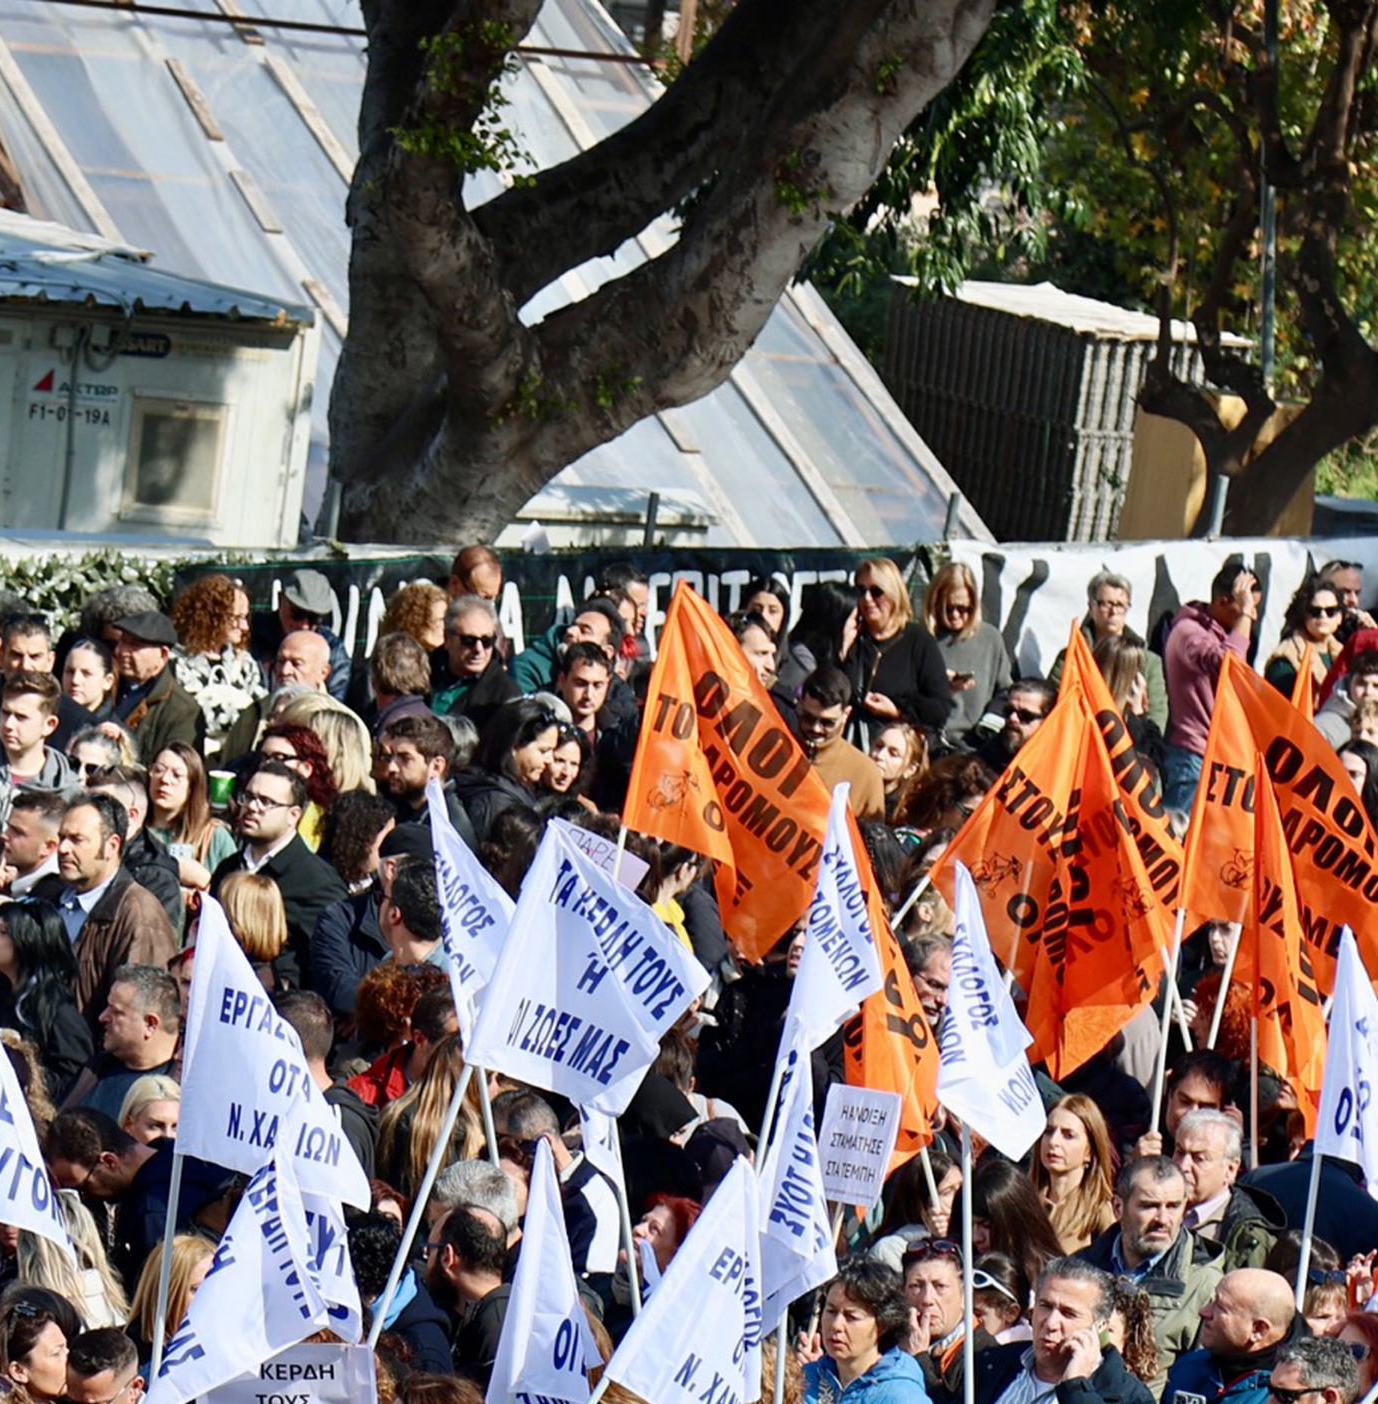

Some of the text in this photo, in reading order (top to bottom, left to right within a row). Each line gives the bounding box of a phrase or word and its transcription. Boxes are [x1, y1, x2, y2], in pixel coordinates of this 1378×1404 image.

[623, 948, 686, 1022] ΤΟΥΣ
[521, 1003, 583, 1063] ΖΩΕΣ
[568, 1024, 631, 1086] ΜΑΣ
[226, 1102, 341, 1167] Ν. ΧΑΙΩΝ
[830, 1132, 884, 1156] ΣΤΑΜΑΤΗΣΕ
[841, 1162, 876, 1184] ΤΕΜΠΗ
[260, 1363, 335, 1381] ΚΕΡΔΗ
[673, 1352, 703, 1393] Ν.
